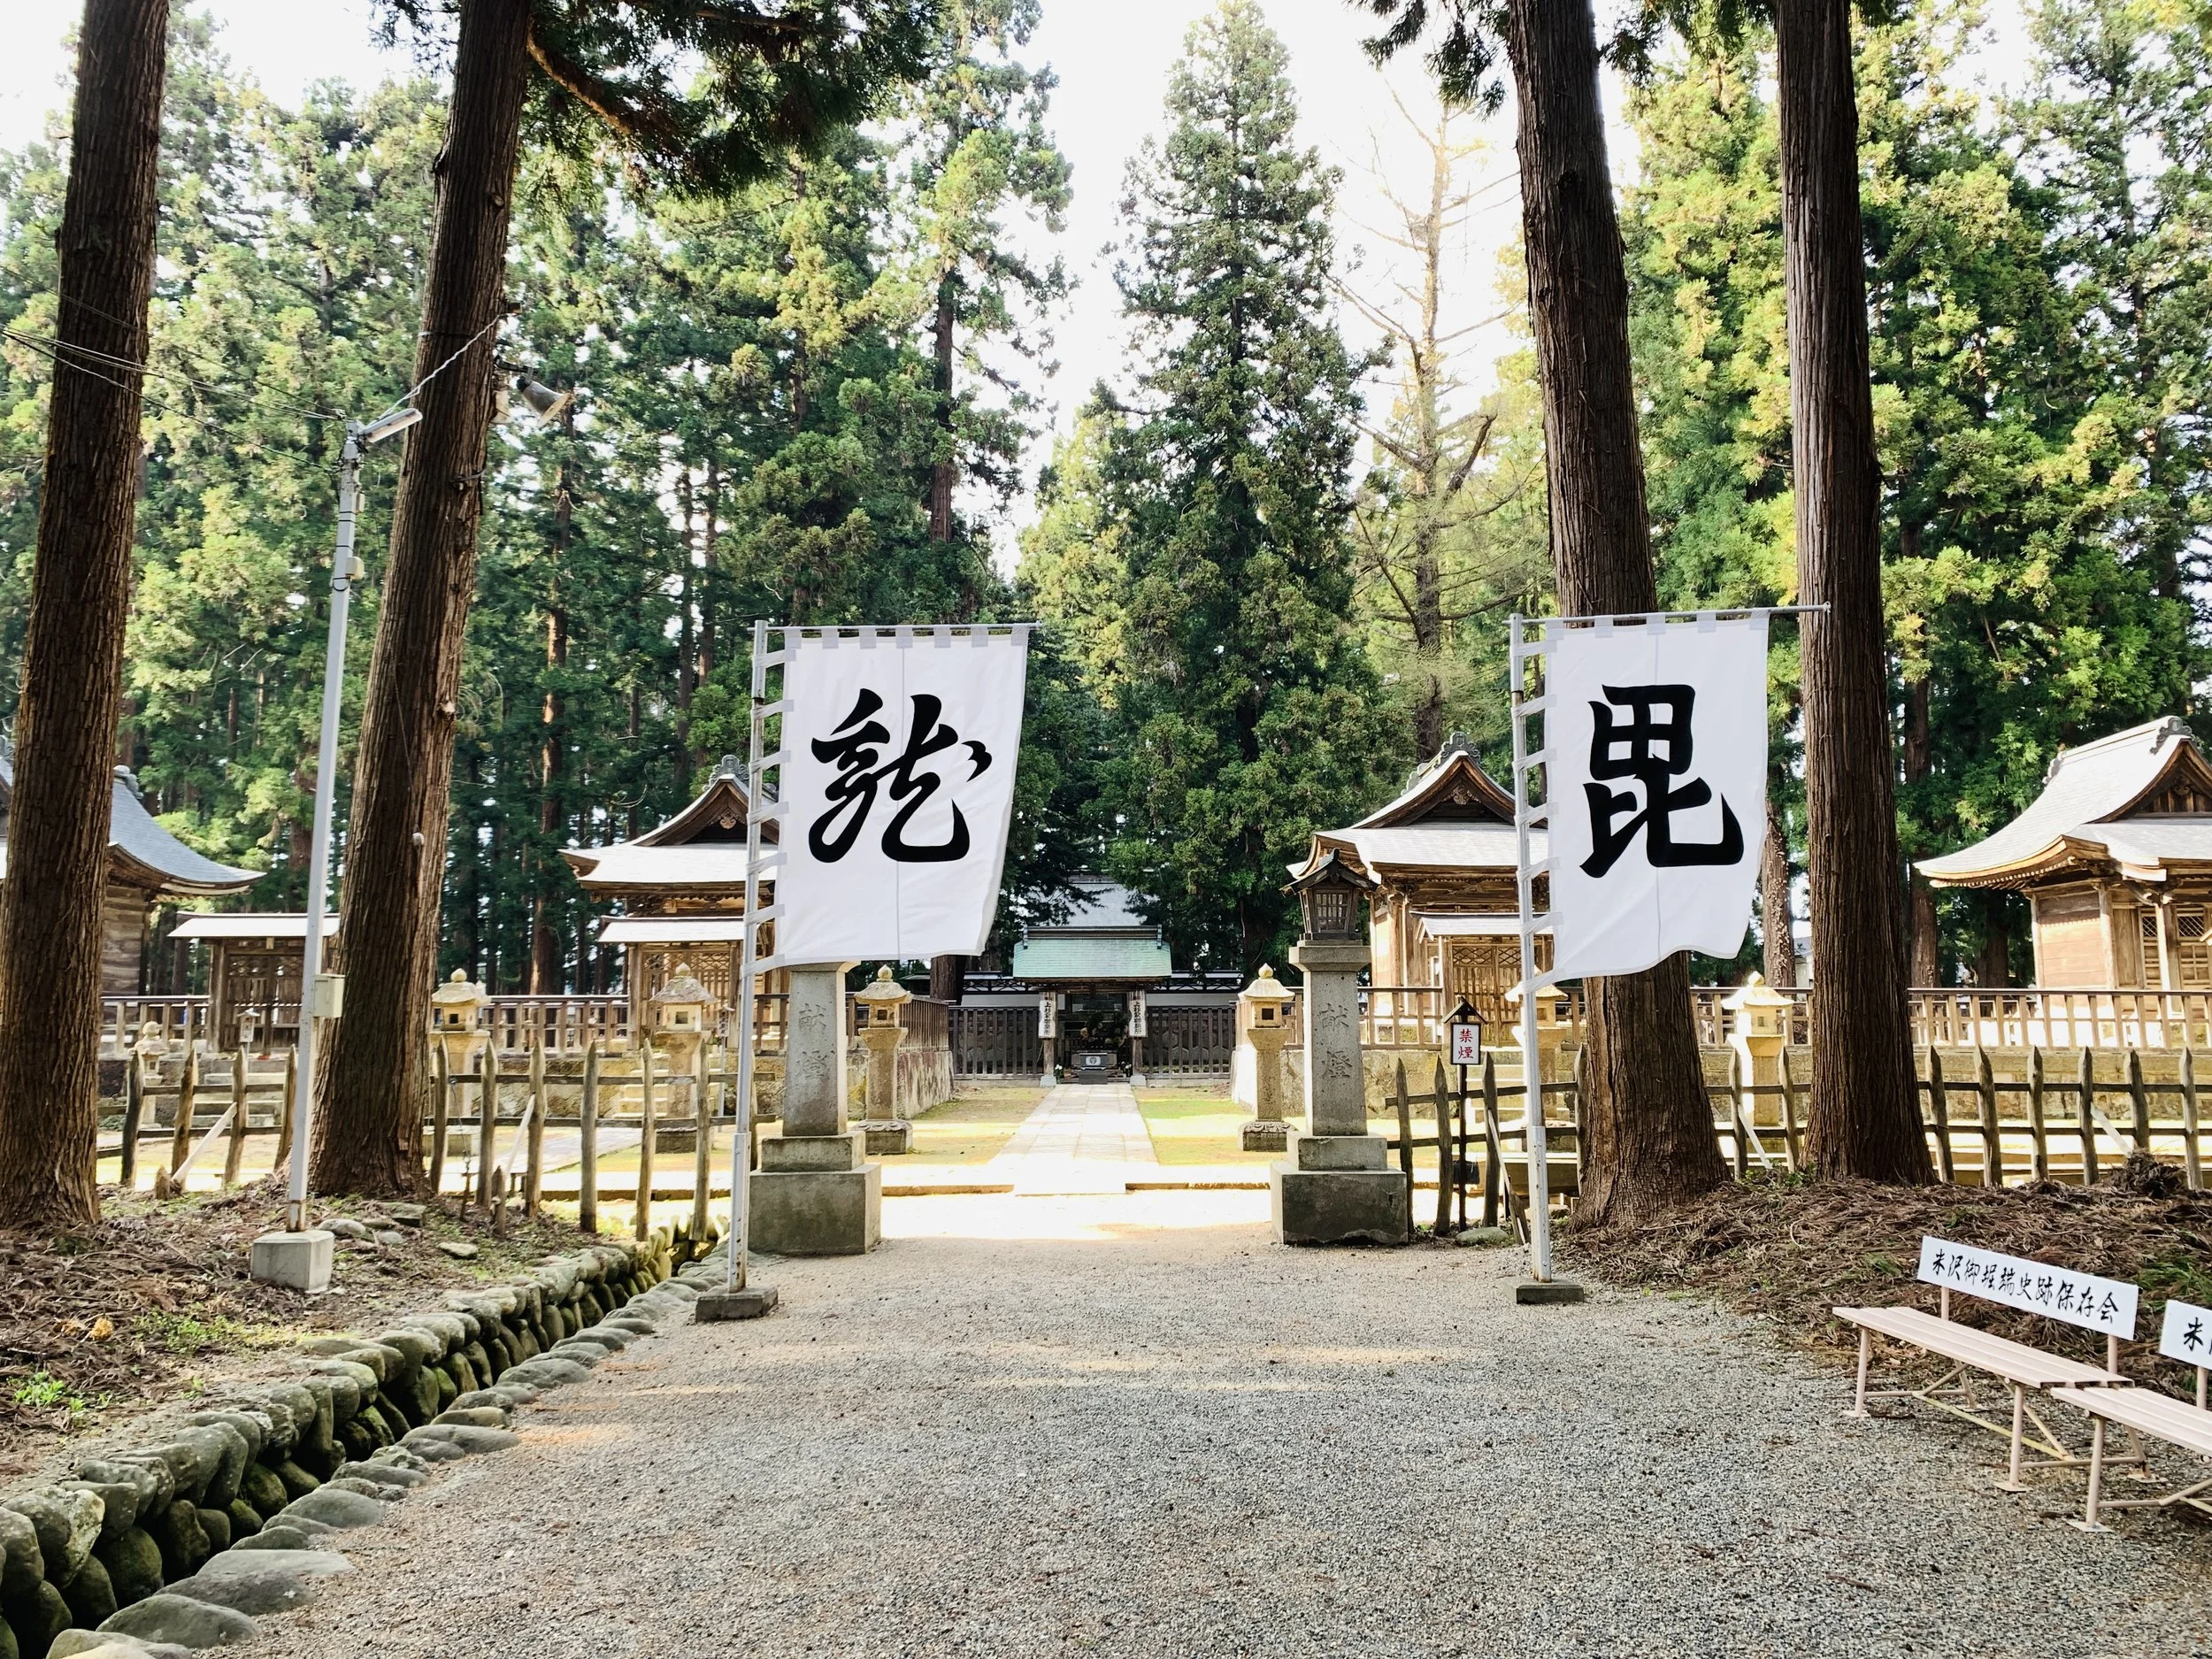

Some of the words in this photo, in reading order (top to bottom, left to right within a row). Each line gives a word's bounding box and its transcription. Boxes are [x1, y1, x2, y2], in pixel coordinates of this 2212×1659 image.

[1579, 684, 1744, 878] 毘
[1458, 1028, 1474, 1060] 禁煙
[2184, 1317, 2212, 1356] 米
